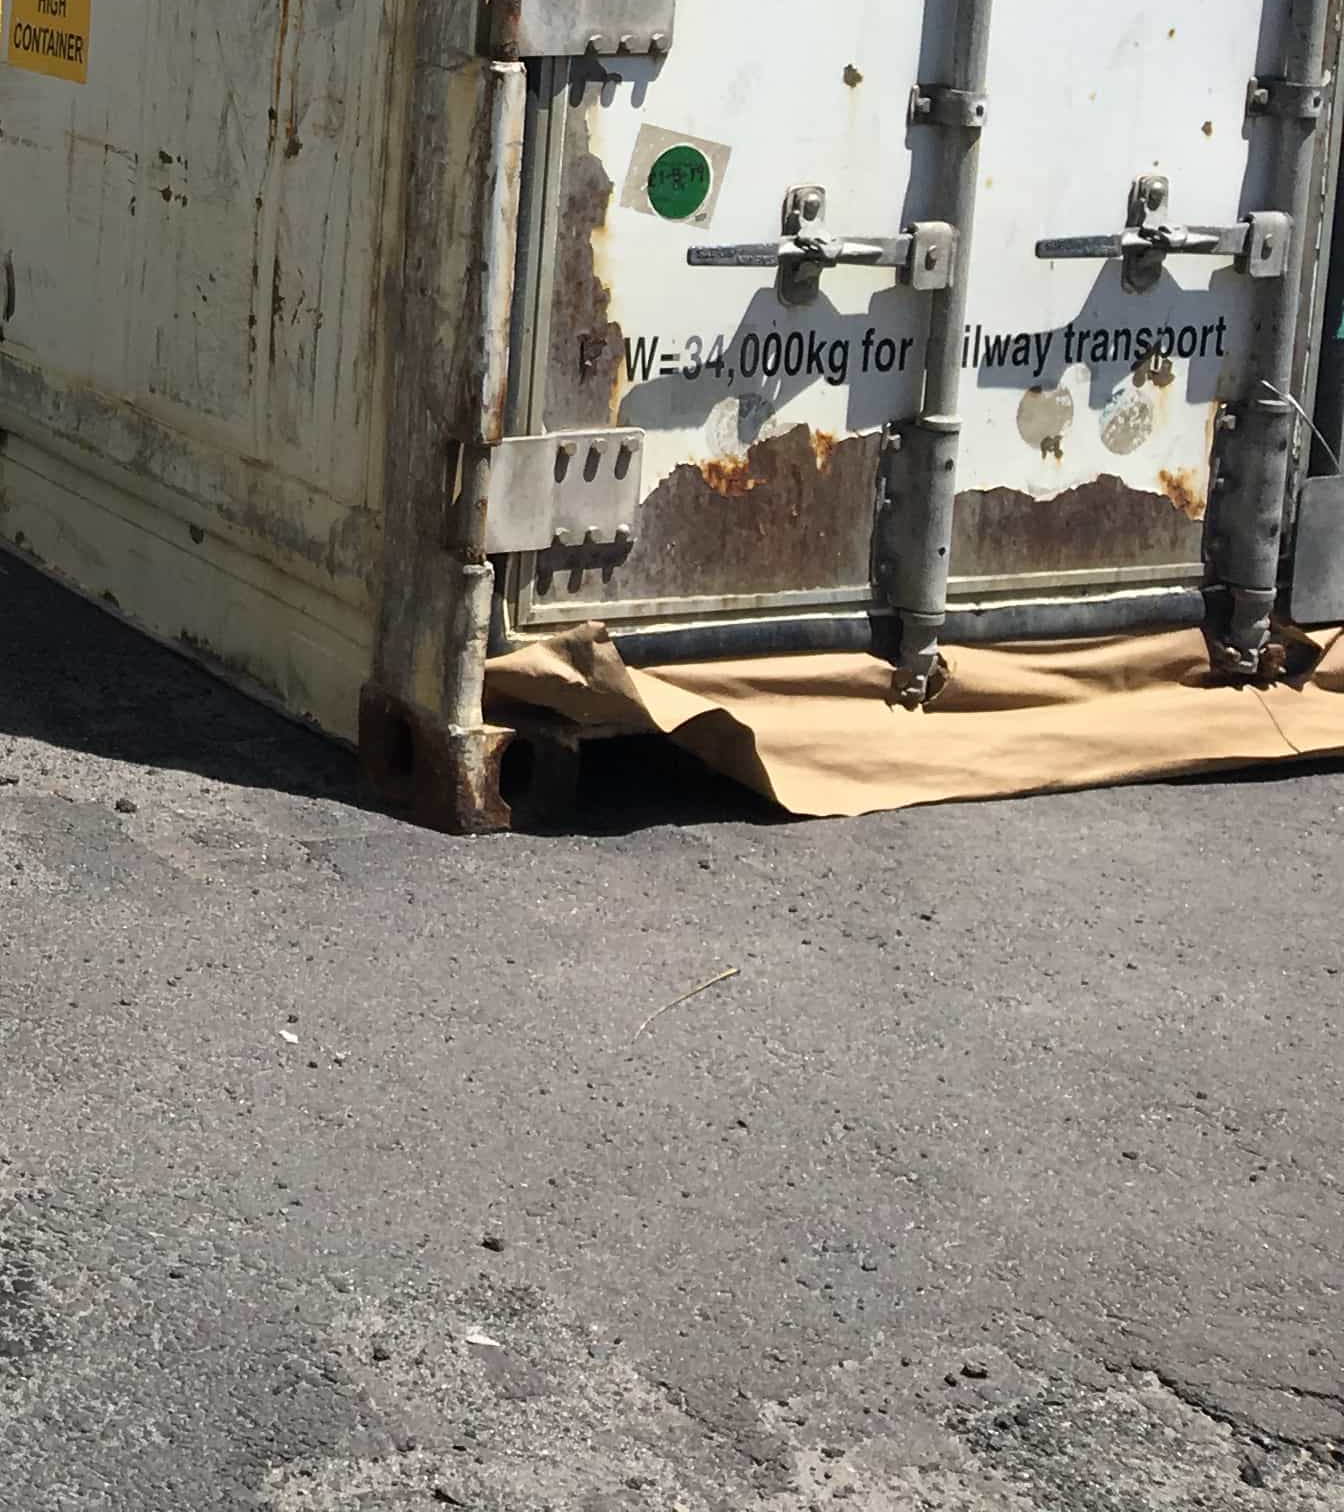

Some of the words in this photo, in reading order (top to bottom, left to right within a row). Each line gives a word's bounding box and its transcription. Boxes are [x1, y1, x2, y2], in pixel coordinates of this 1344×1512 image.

[13, 22, 84, 65] CONTAINER
[861, 326, 914, 373] for
[961, 324, 1053, 378] ilway
[1063, 315, 1226, 368] transport
